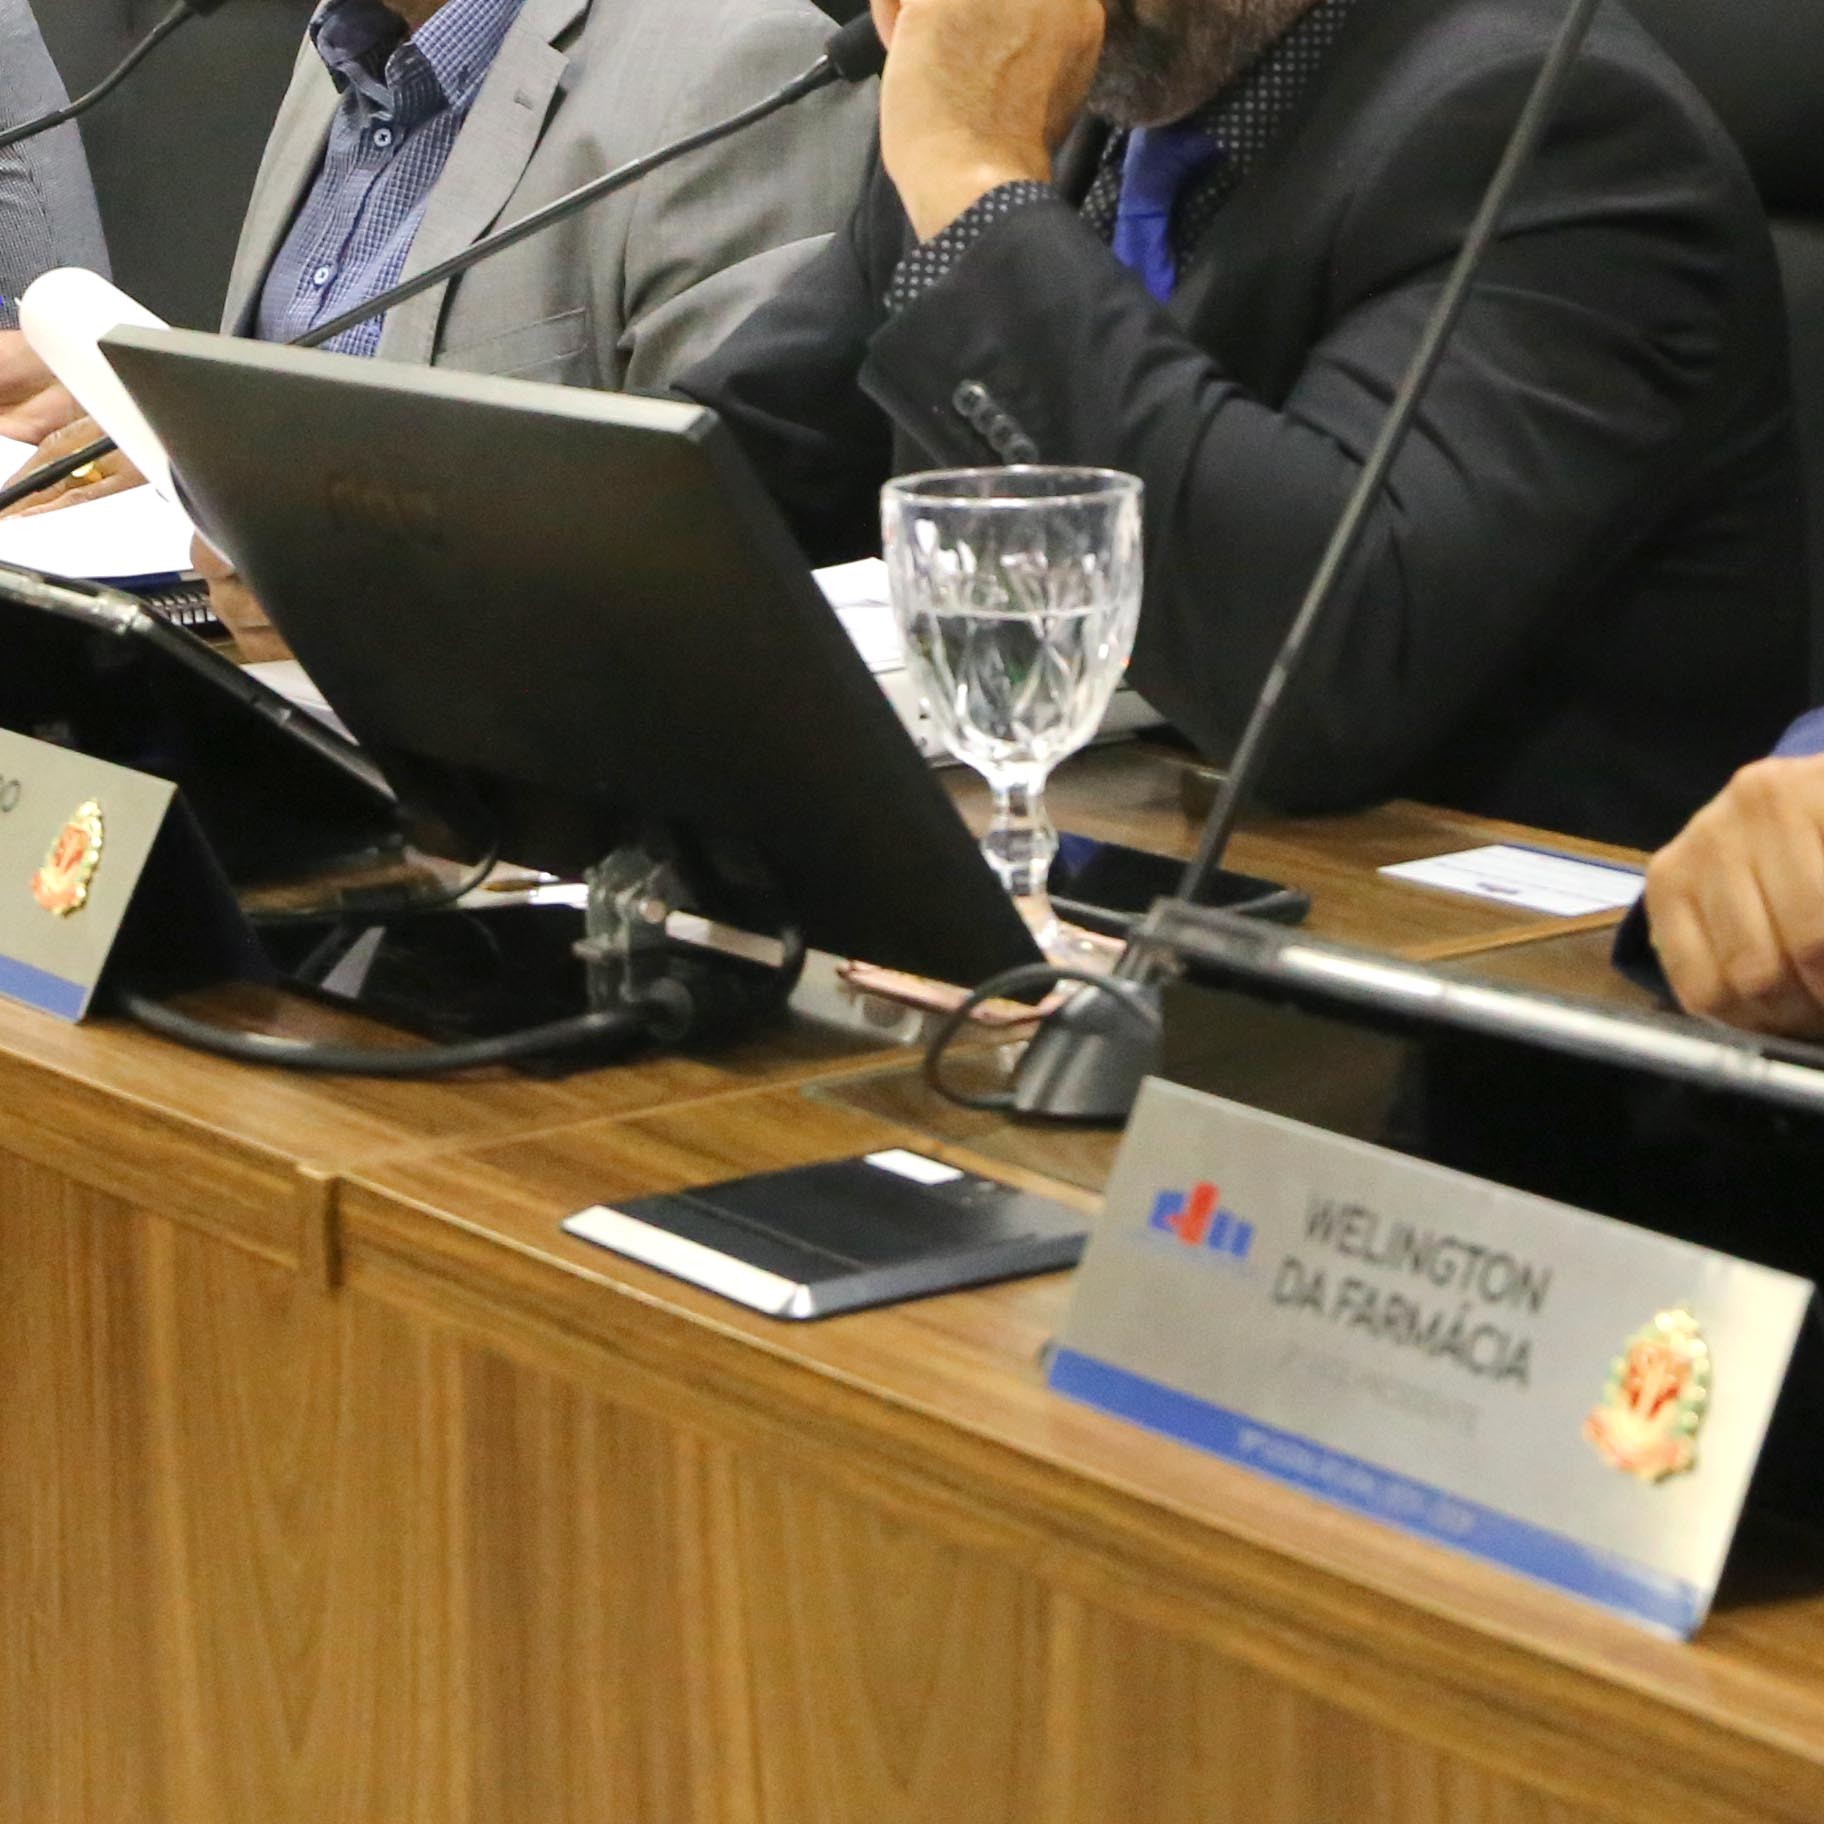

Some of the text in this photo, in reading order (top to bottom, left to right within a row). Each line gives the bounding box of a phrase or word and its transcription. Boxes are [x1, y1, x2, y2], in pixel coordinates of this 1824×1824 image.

[1305, 1193, 1554, 1314] WELINGTON
[1271, 1255, 1325, 1314] DA
[1329, 1276, 1531, 1389] FARMÁCIA
